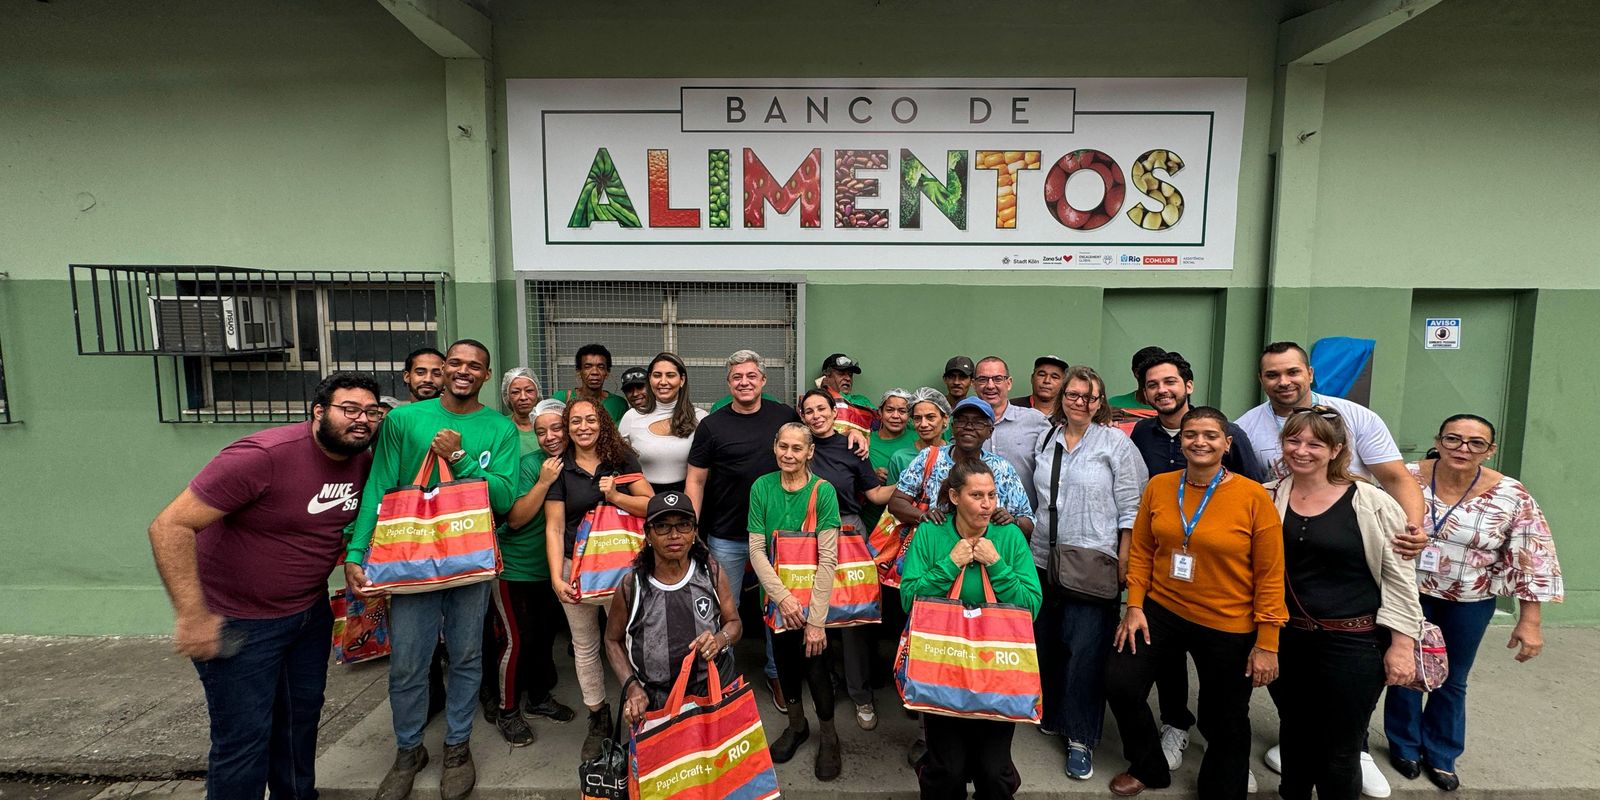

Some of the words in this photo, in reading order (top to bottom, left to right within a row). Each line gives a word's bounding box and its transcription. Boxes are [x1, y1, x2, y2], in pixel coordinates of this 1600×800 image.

[726, 96, 918, 124] BANCO
[969, 97, 1029, 124] DE
[567, 147, 1186, 231] ALIMENTOS
[225, 310, 235, 335] Consul
[319, 483, 354, 498] NIKE
[342, 498, 358, 511] SB
[386, 527, 406, 537] Papel
[406, 527, 427, 536] Craft
[450, 518, 474, 533] RIO
[593, 539, 612, 548] Papel
[791, 574, 810, 583] Papel
[847, 569, 865, 581] RIO
[924, 643, 946, 656] Papel
[946, 646, 968, 659] Craft
[995, 651, 1020, 666] RIO
[655, 773, 679, 791] Papel
[679, 765, 704, 781] Craft
[727, 740, 751, 763] RIO
